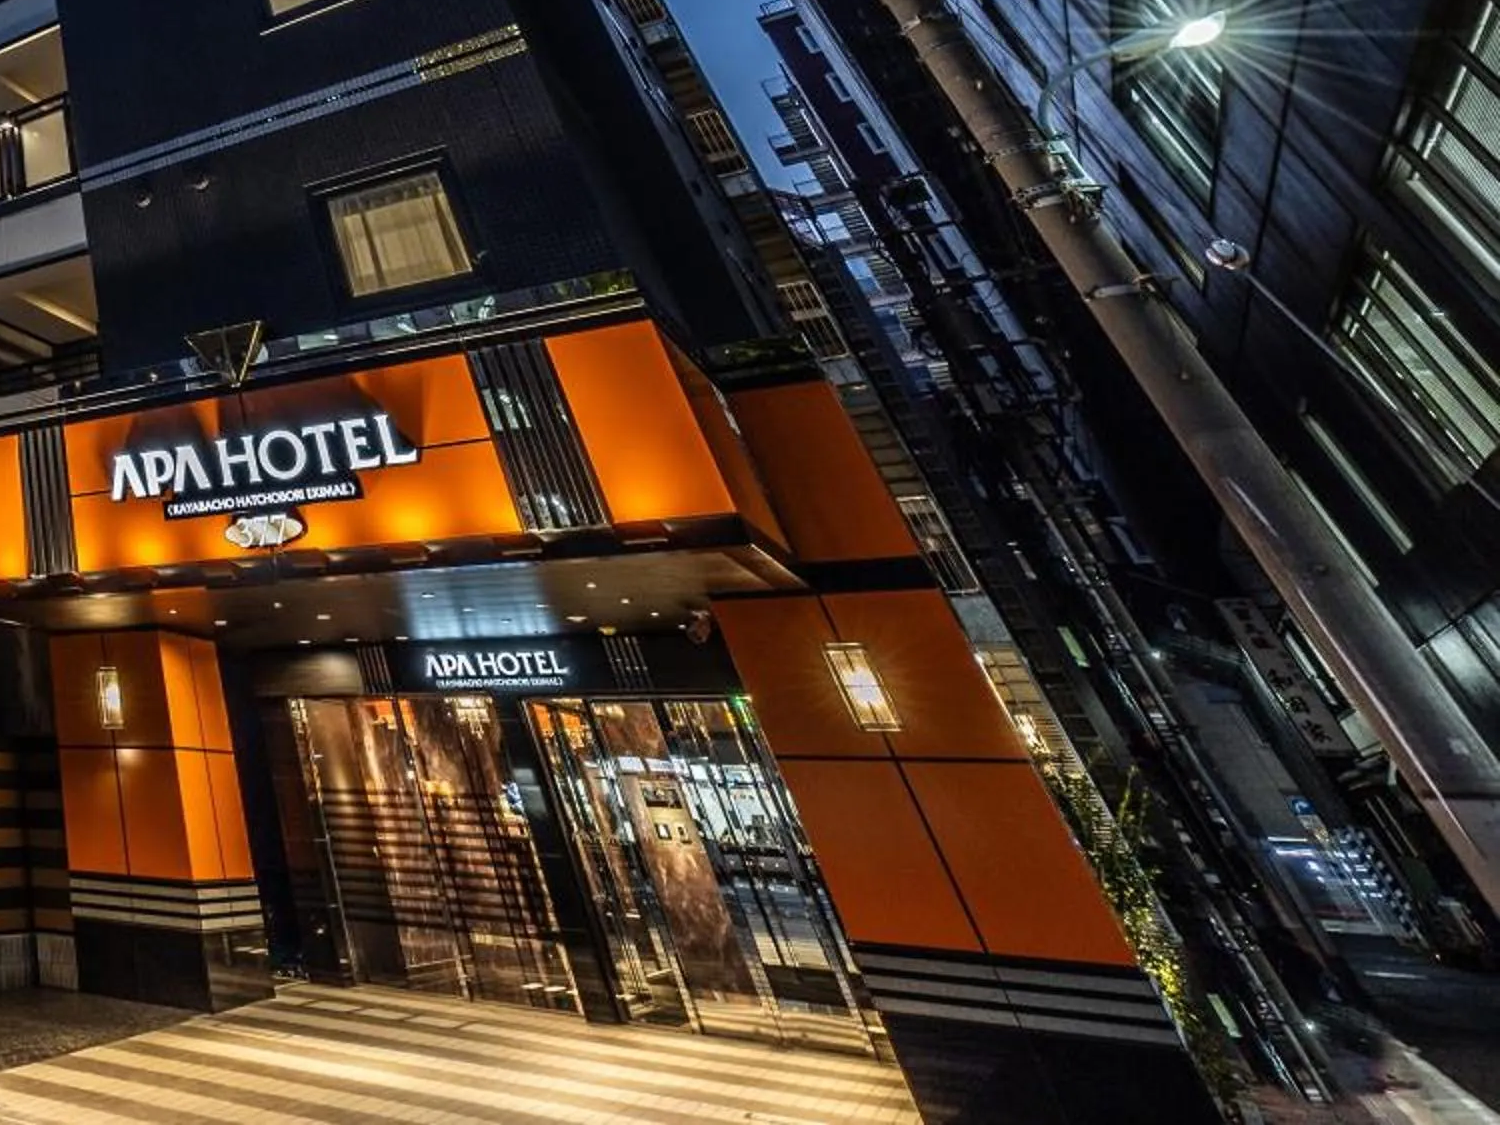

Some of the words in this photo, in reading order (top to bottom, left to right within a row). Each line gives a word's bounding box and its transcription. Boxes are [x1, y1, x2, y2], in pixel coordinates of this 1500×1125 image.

[111, 444, 214, 501] APA
[215, 413, 418, 486] HOTEL
[425, 653, 476, 678] APA
[476, 650, 570, 676] HOTEL
